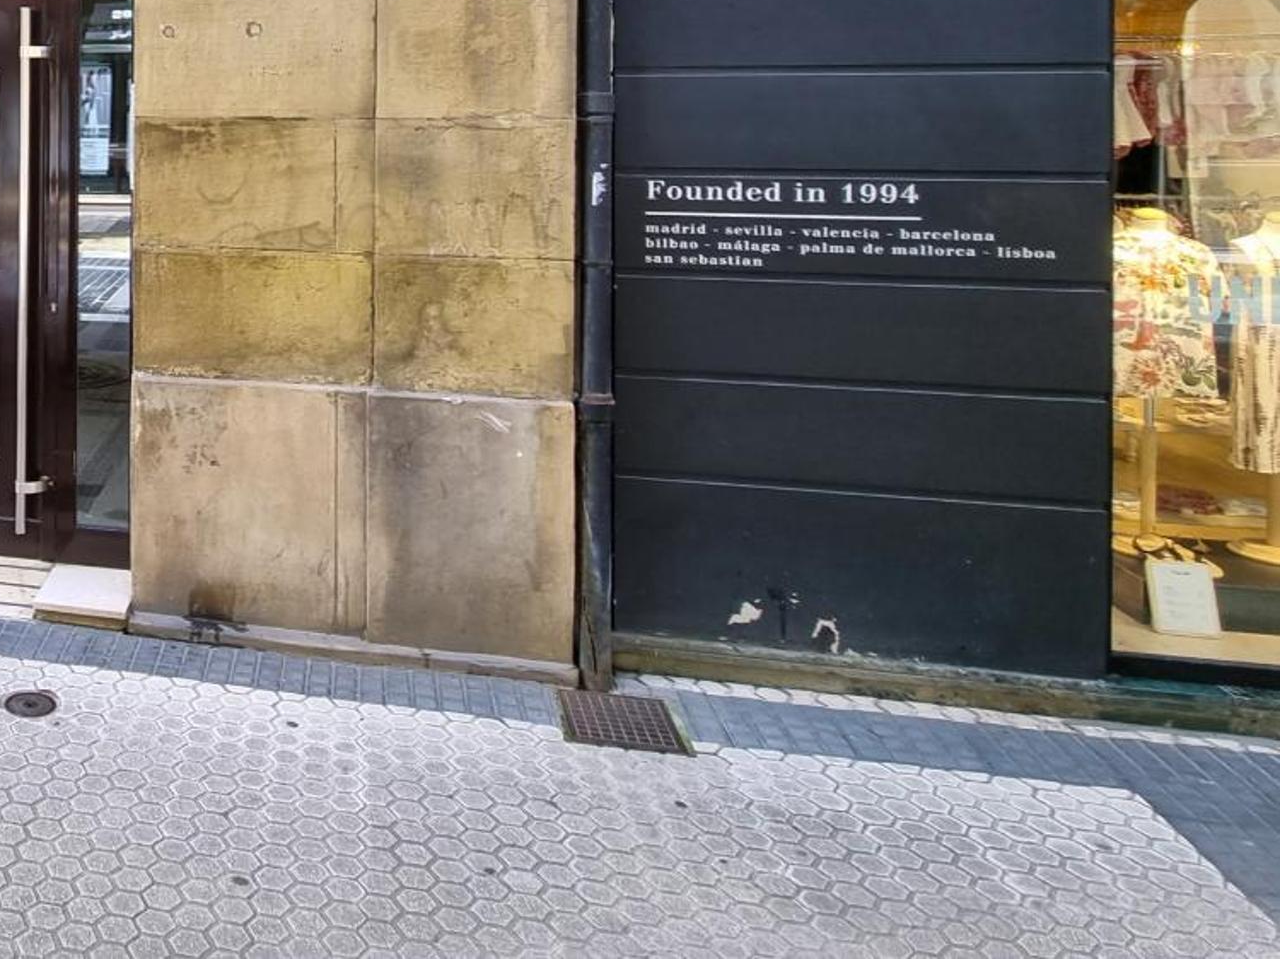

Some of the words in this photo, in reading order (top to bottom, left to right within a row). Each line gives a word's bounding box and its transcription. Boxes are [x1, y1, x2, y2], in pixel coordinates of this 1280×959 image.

[646, 179, 783, 203] Founded
[793, 182, 826, 204] in
[841, 183, 920, 206] 1994
[645, 223, 707, 235] madrid
[724, 224, 783, 237] sevilla
[800, 226, 880, 240] valencia
[900, 228, 995, 242] barcelona
[645, 238, 699, 250] bilbao
[717, 240, 781, 255] málaga
[799, 242, 856, 256] palma
[863, 243, 885, 256] de
[891, 245, 976, 258] mallorca
[997, 247, 1056, 260] lisboa
[645, 255, 674, 265] san
[680, 254, 764, 267] sebastian
